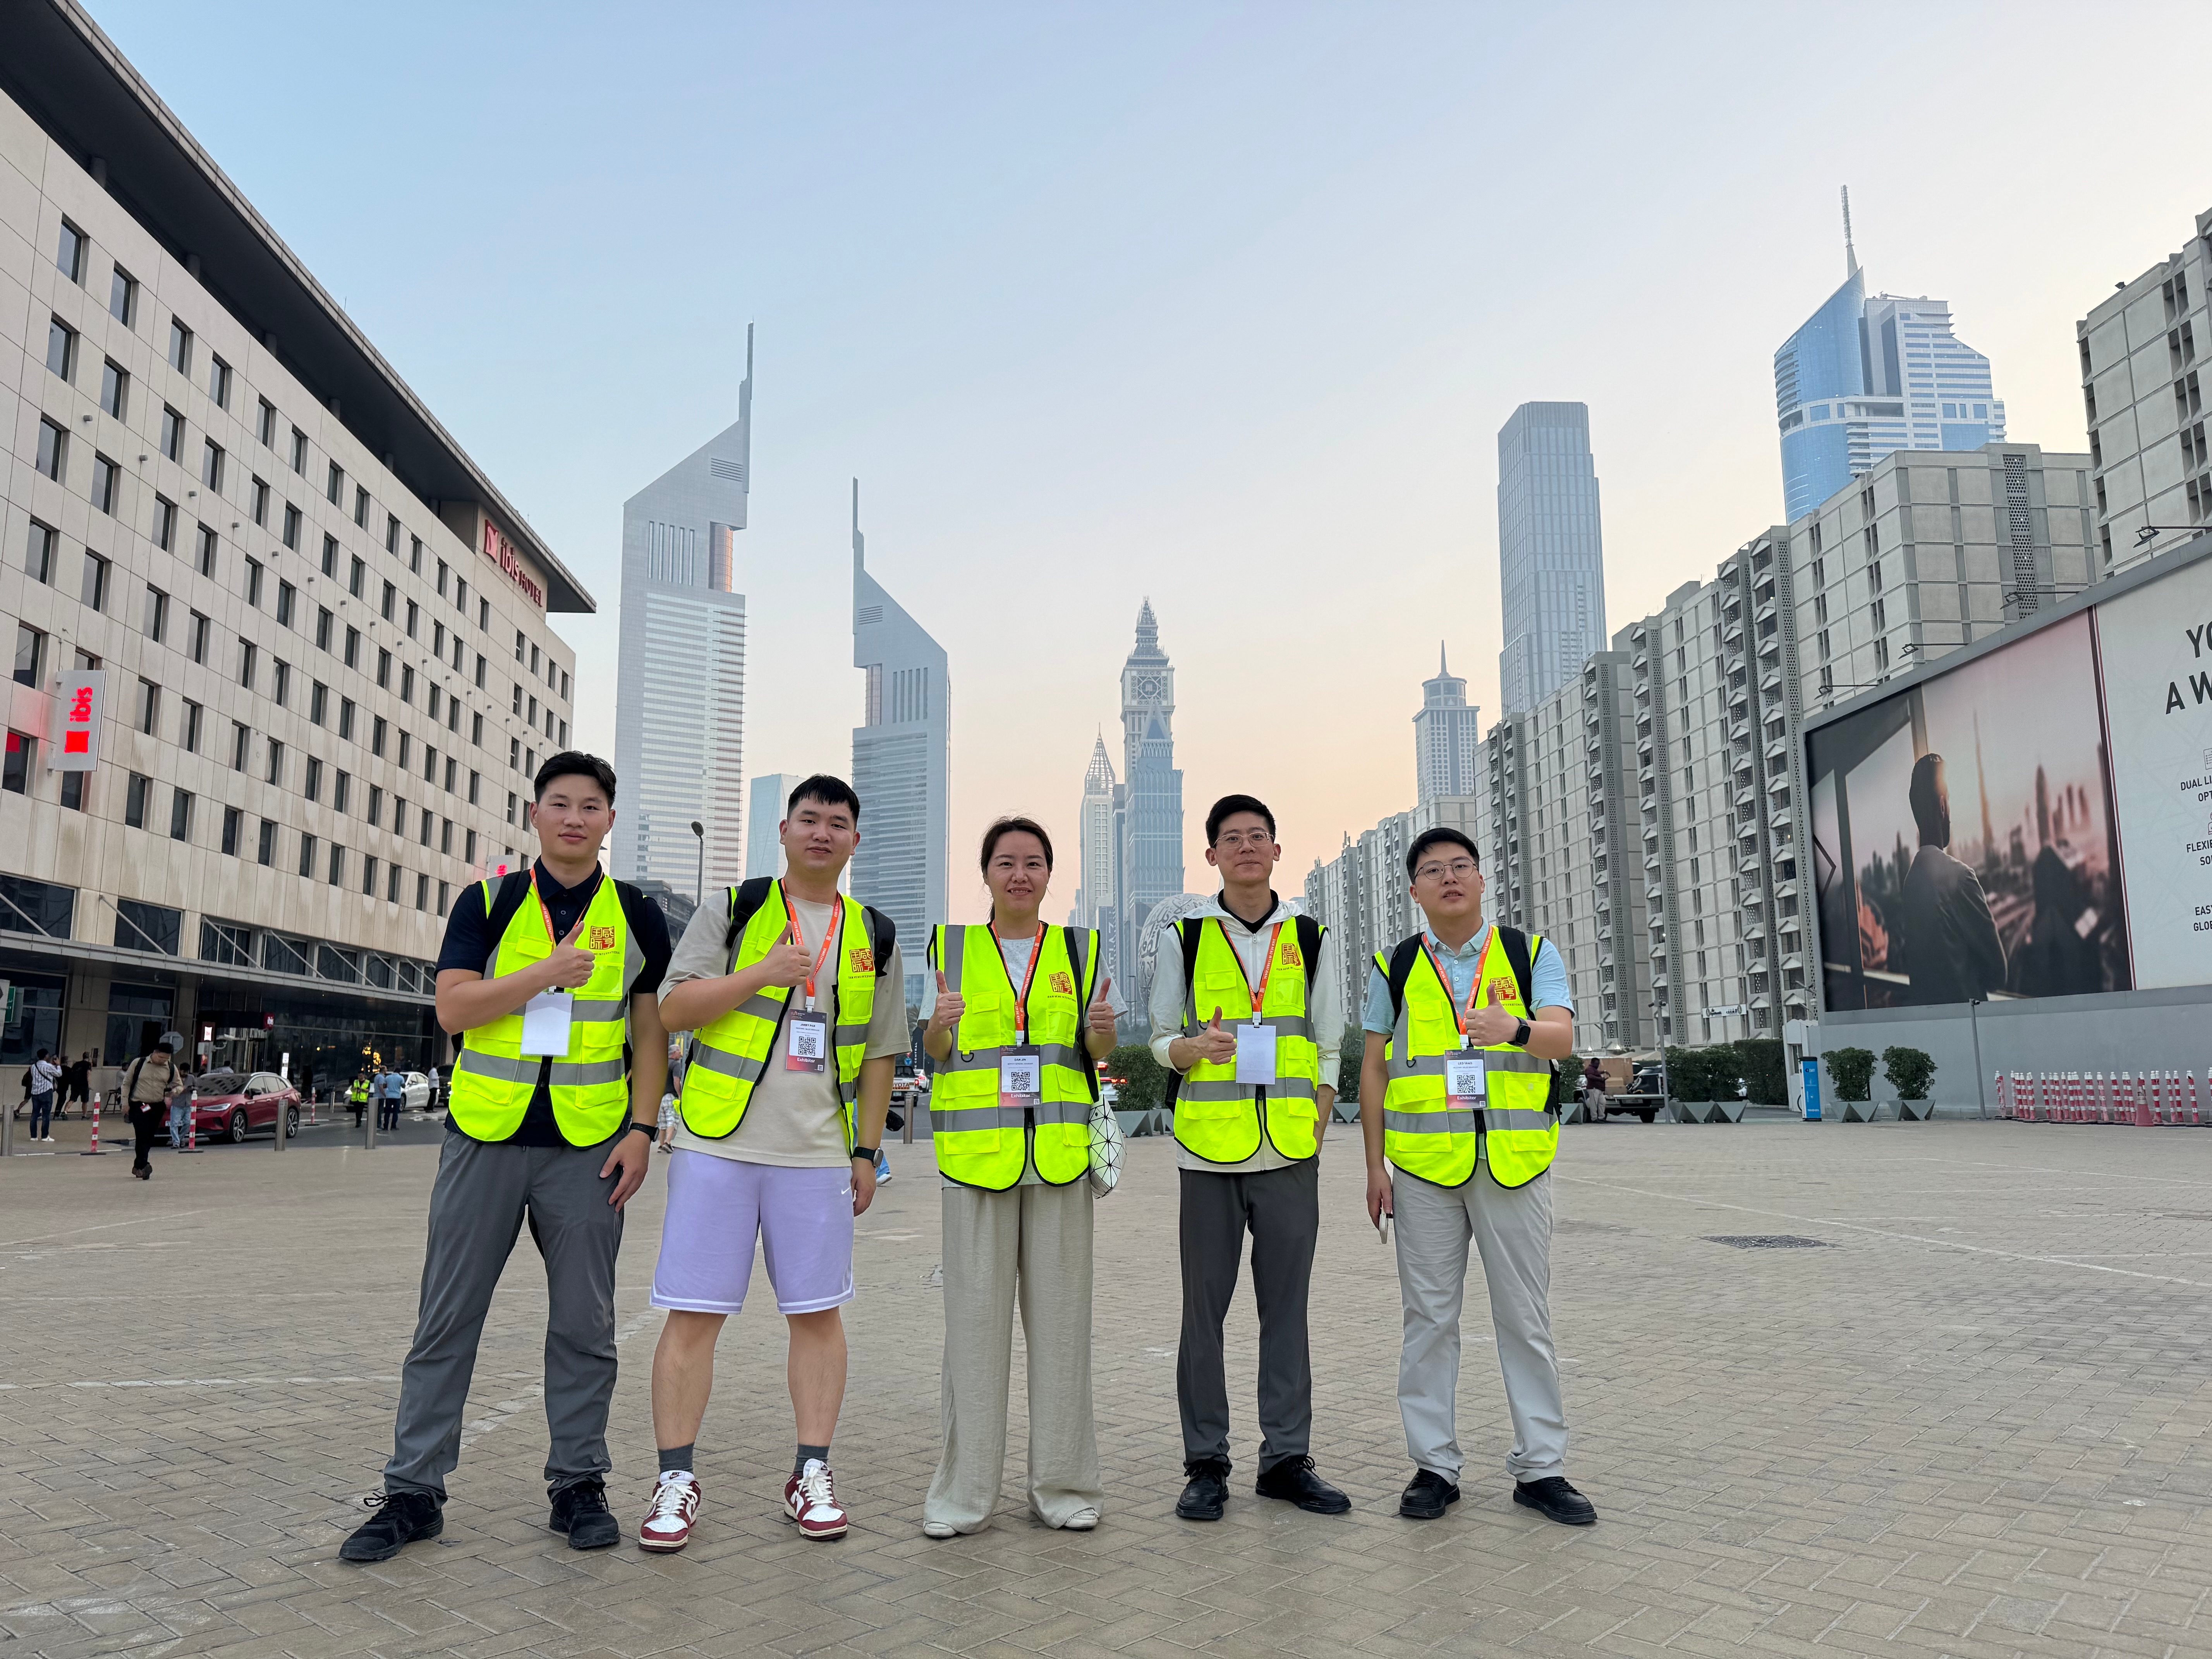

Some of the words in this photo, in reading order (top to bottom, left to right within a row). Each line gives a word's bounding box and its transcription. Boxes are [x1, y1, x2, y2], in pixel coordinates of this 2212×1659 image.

[500, 538, 519, 582] ibis
[519, 570, 542, 607] HOTEL
[69, 687, 93, 722] ibis
[2166, 682, 2185, 714] A
[2181, 778, 2202, 790] DUAL
[2200, 855, 2212, 866] SO
